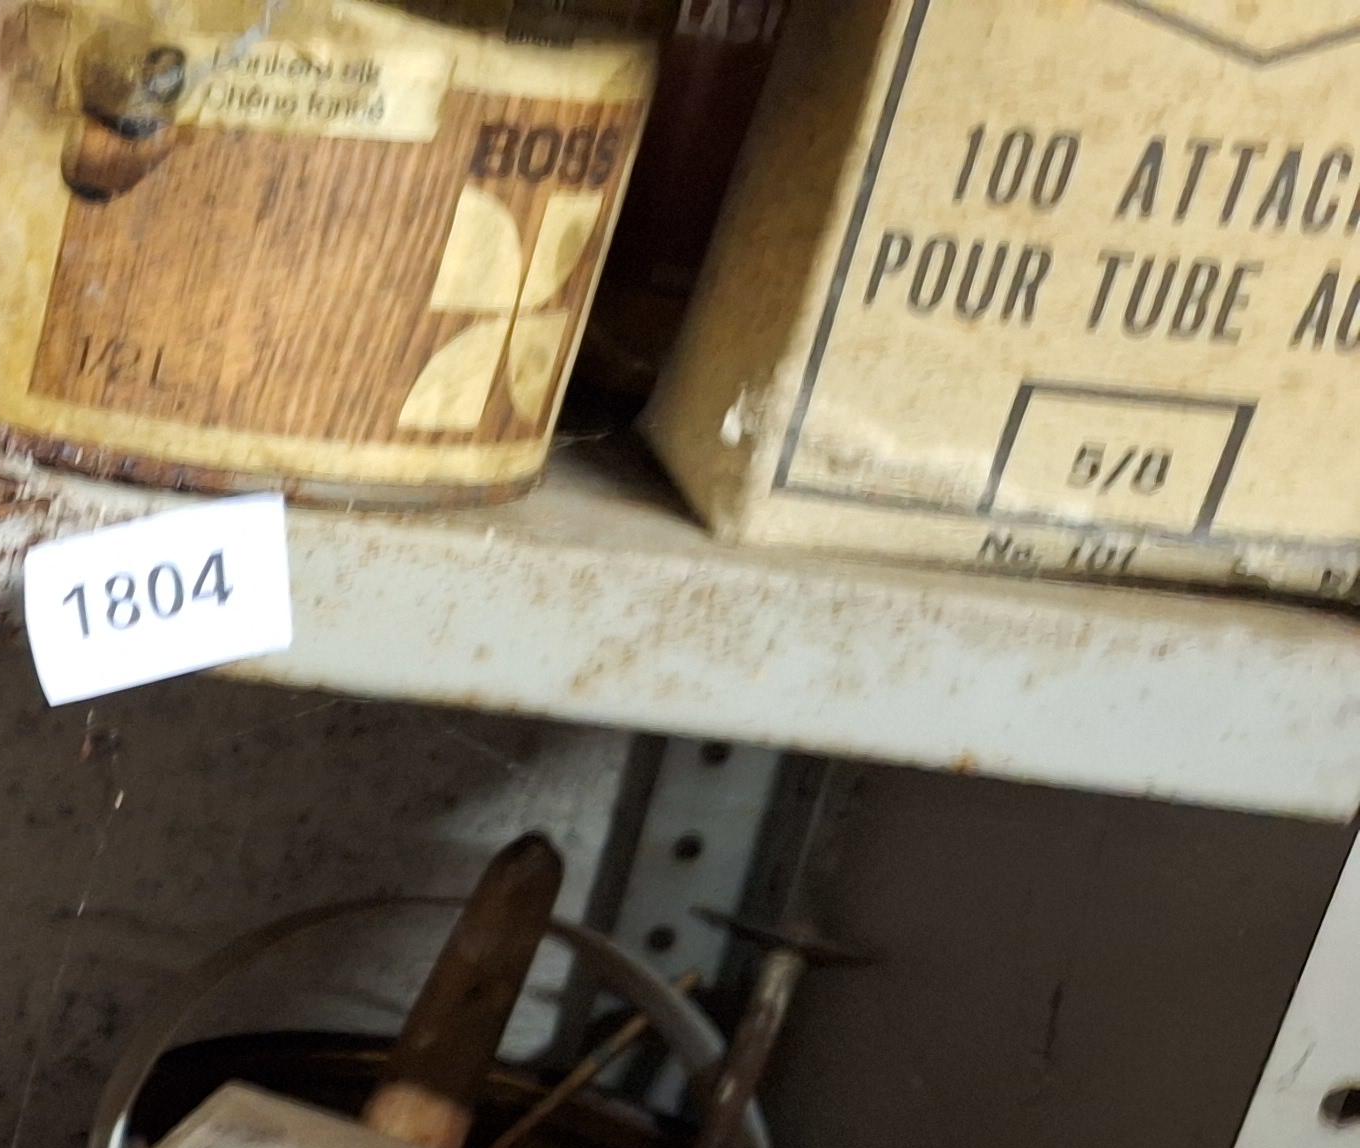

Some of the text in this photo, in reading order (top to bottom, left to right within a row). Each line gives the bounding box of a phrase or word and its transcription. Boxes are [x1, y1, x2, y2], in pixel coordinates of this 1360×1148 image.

[468, 119, 622, 190] BOSS
[952, 123, 1080, 212] 100
[863, 226, 1054, 328] POUR
[1086, 249, 1265, 347] TUBE
[62, 547, 234, 640] 1804
